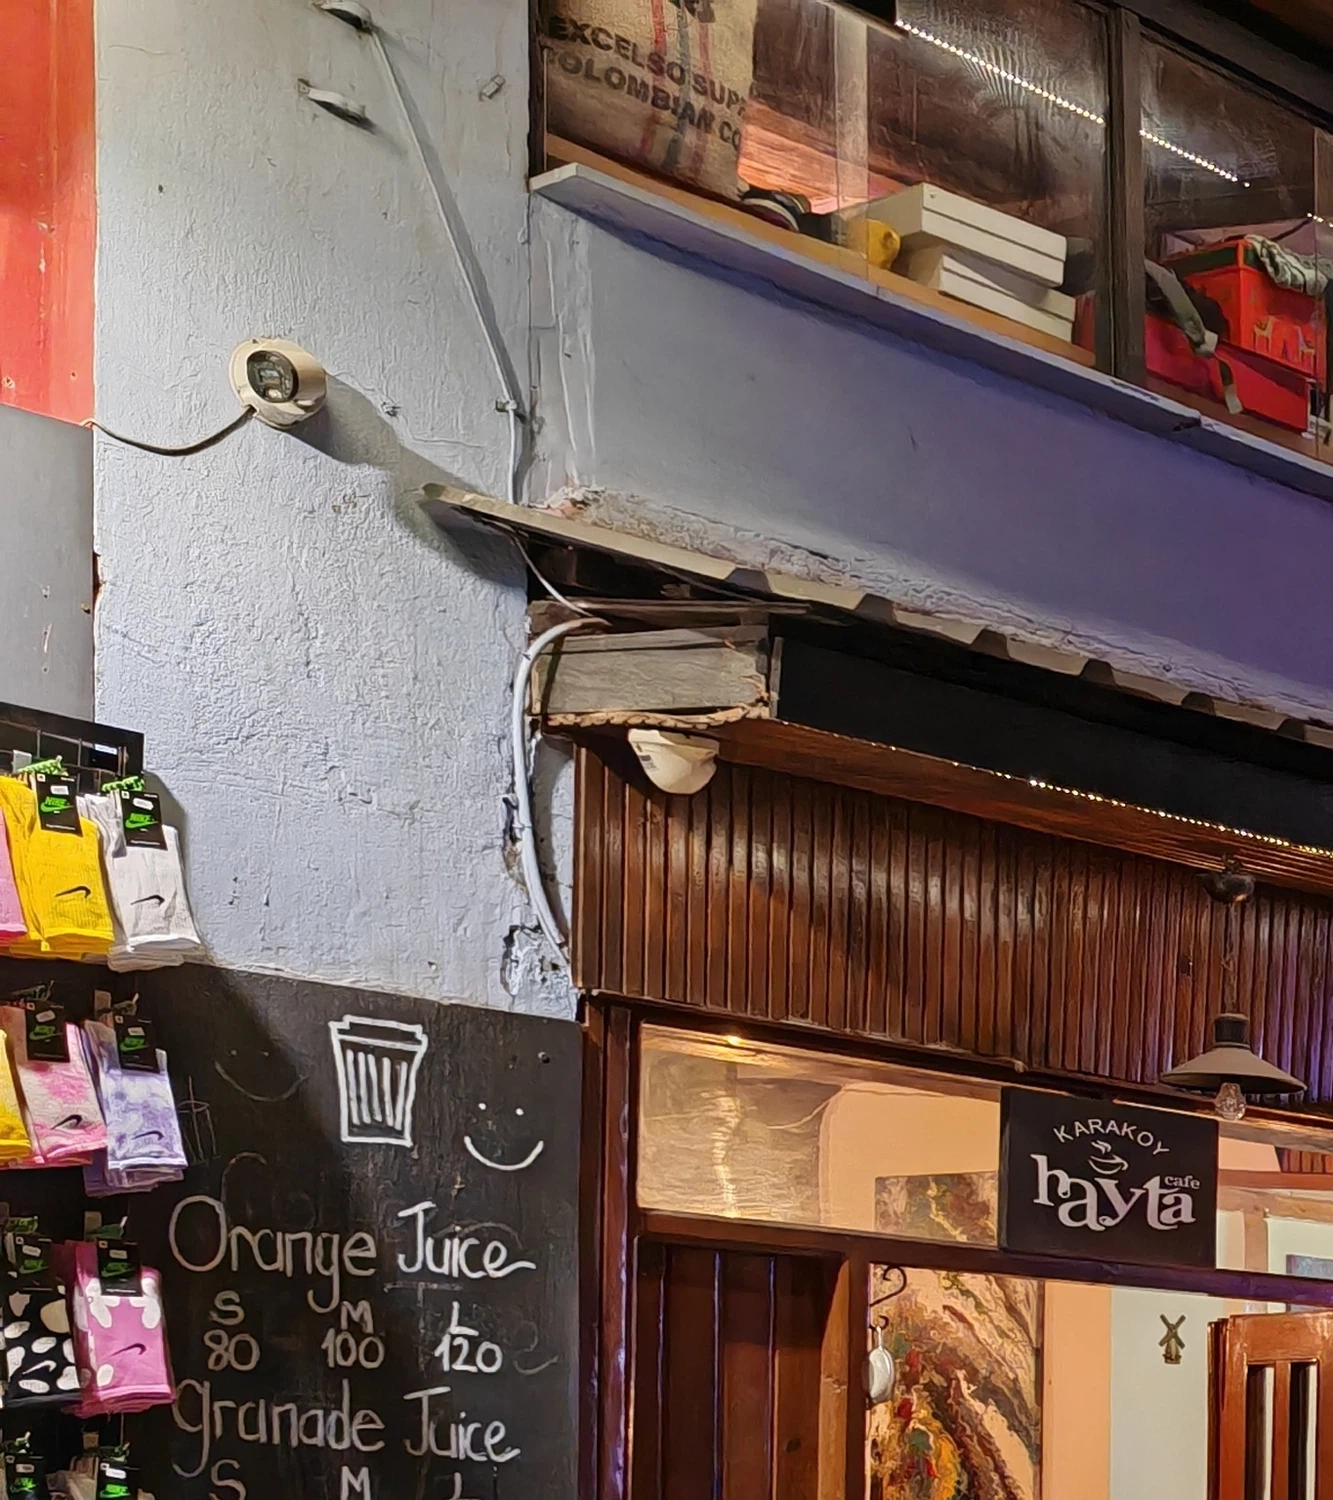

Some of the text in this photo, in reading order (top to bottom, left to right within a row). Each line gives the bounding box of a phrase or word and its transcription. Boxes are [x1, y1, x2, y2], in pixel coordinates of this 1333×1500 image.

[549, 15, 686, 86] EXCELSO
[1053, 1118, 1171, 1155] KARAKOY
[1030, 1153, 1197, 1231] hayta
[1164, 1175, 1200, 1190] cafe
[169, 1194, 537, 1314] Orange Juice
[209, 1289, 480, 1337] S M L
[203, 1326, 504, 1373] 80 100 120
[403, 1385, 522, 1463] Juice
